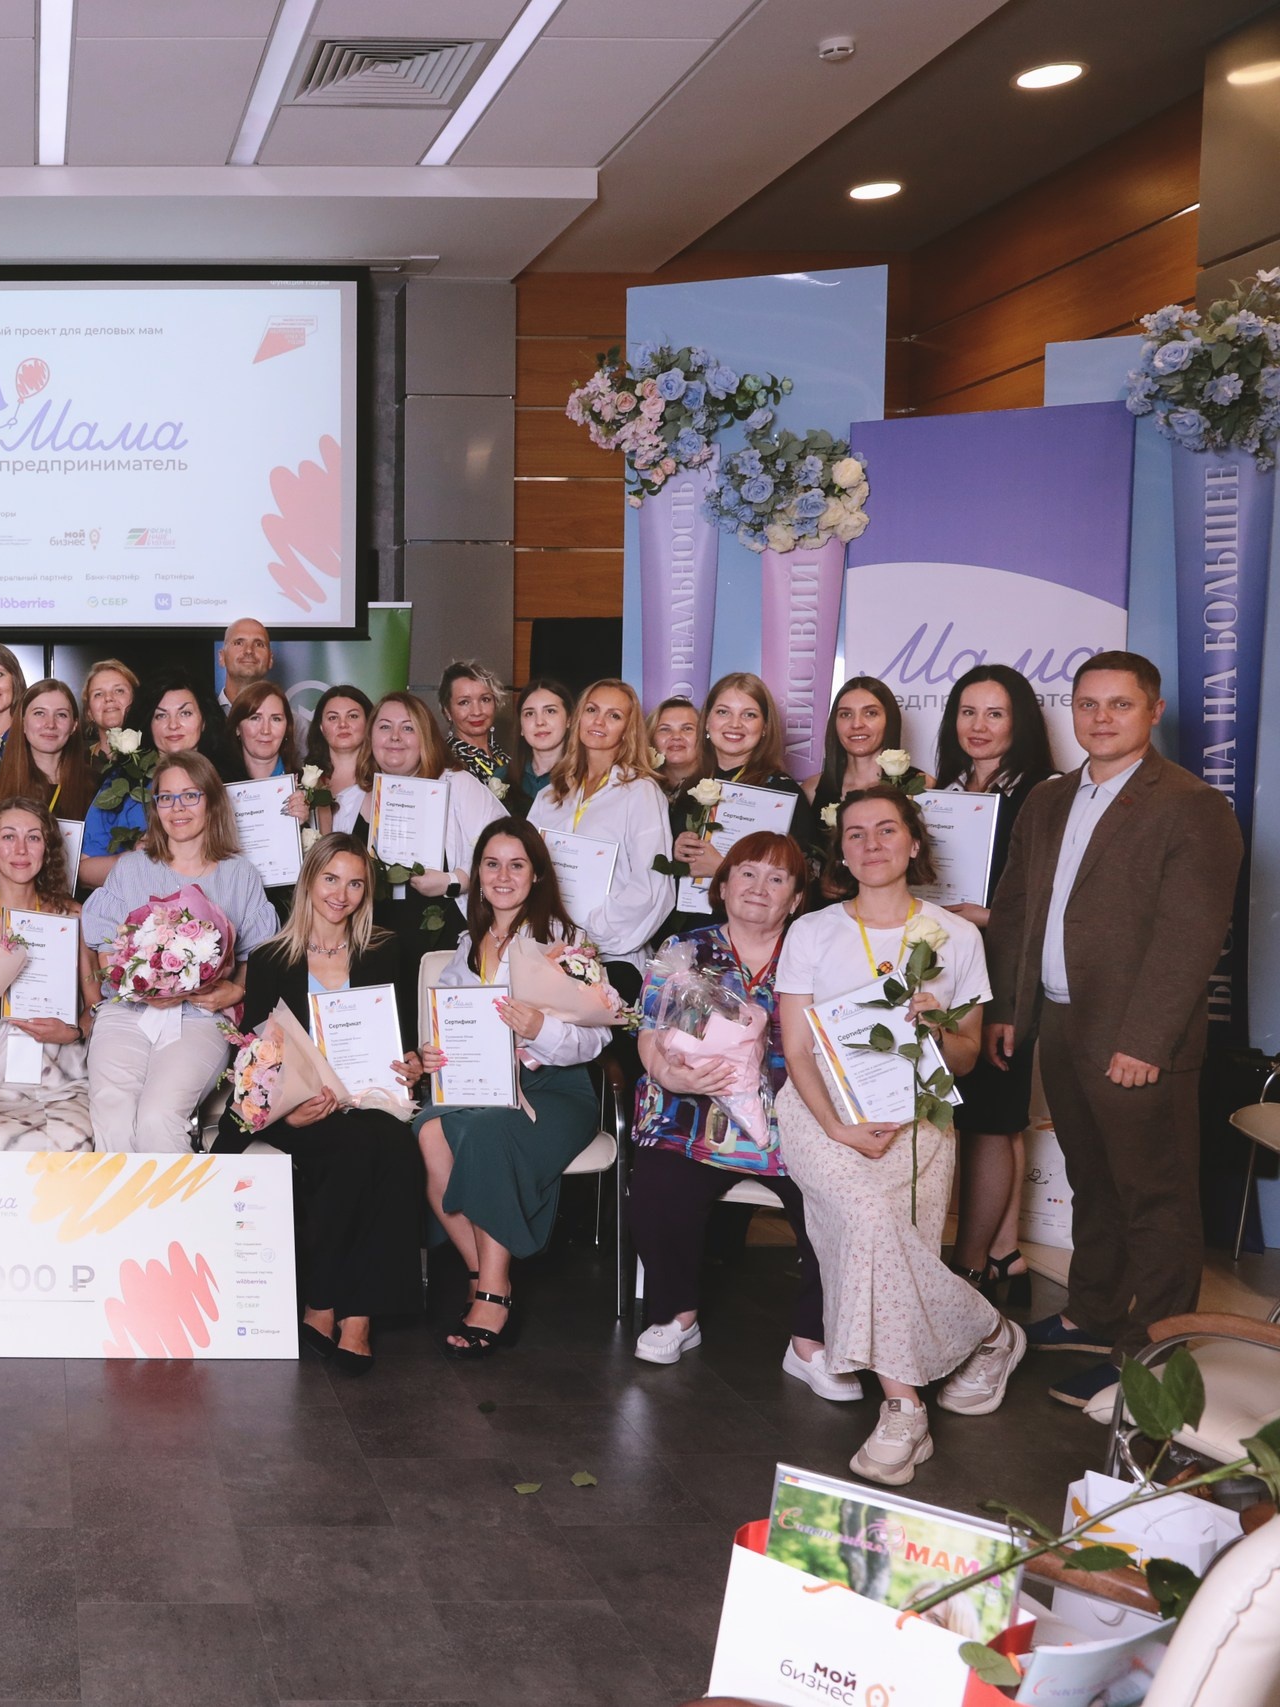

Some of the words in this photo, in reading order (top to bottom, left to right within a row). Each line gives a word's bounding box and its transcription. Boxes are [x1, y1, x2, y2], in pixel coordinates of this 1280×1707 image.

[14, 327, 57, 338] проект
[59, 328, 81, 336] для
[84, 327, 135, 336] деловых
[0, 399, 188, 451] Мама
[0, 458, 188, 475] предприниматель
[64, 529, 86, 538] мой
[49, 536, 86, 546] бизнес
[1203, 465, 1239, 653] БОЛЬШЕЕ
[671, 481, 696, 670] РЕАЛЬНОСТЬ
[101, 598, 128, 606] СБЕР
[780, 561, 819, 763] ДЕЙСТВИЙ
[1203, 667, 1237, 723] НА
[386, 801, 416, 809] Сертификат
[234, 809, 264, 818] Сертификат
[722, 811, 756, 822] Сертификат
[328, 1020, 362, 1030] Сертификат
[779, 1658, 855, 1706] бизнес
[813, 1661, 857, 1691] мой
